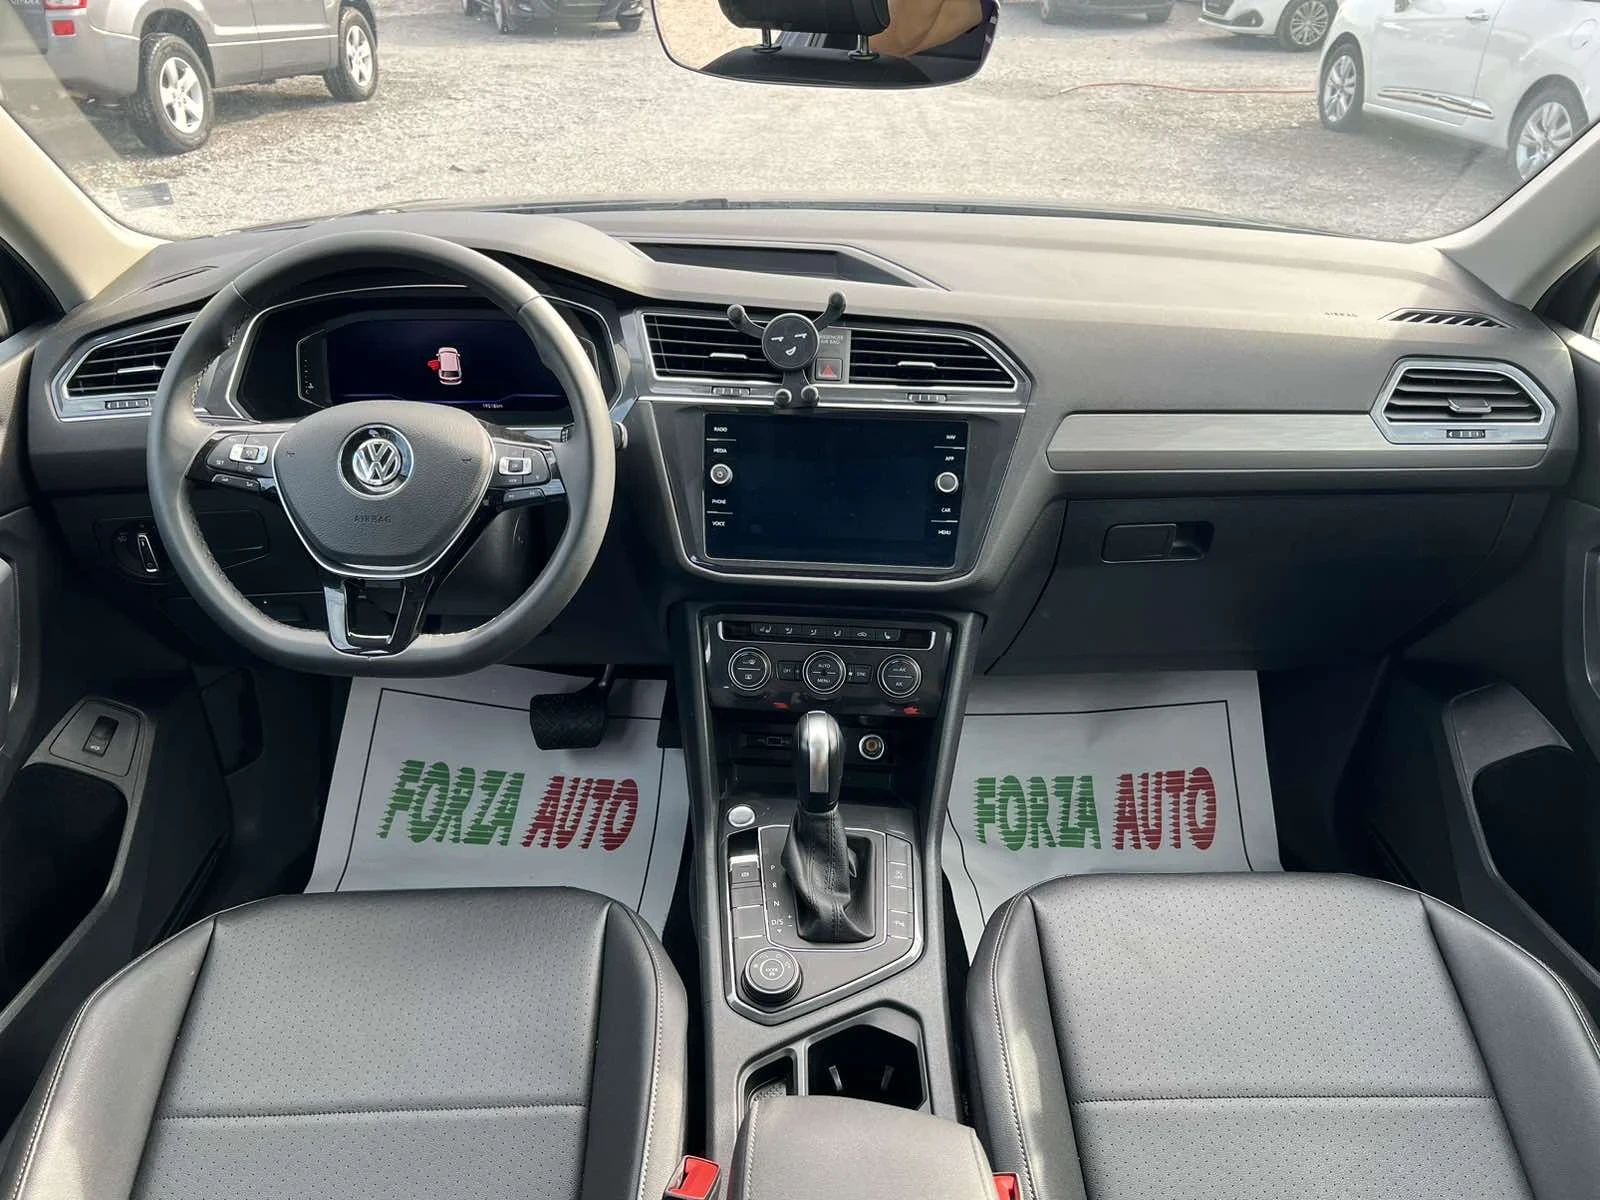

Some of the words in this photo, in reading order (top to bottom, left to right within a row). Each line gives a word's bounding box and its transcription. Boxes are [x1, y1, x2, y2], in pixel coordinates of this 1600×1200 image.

[353, 513, 392, 523] AIRBAG
[376, 759, 526, 847] FORZA
[519, 775, 639, 851] AUTO
[972, 775, 1102, 851] FORZA
[1111, 766, 1217, 851] AUTO
